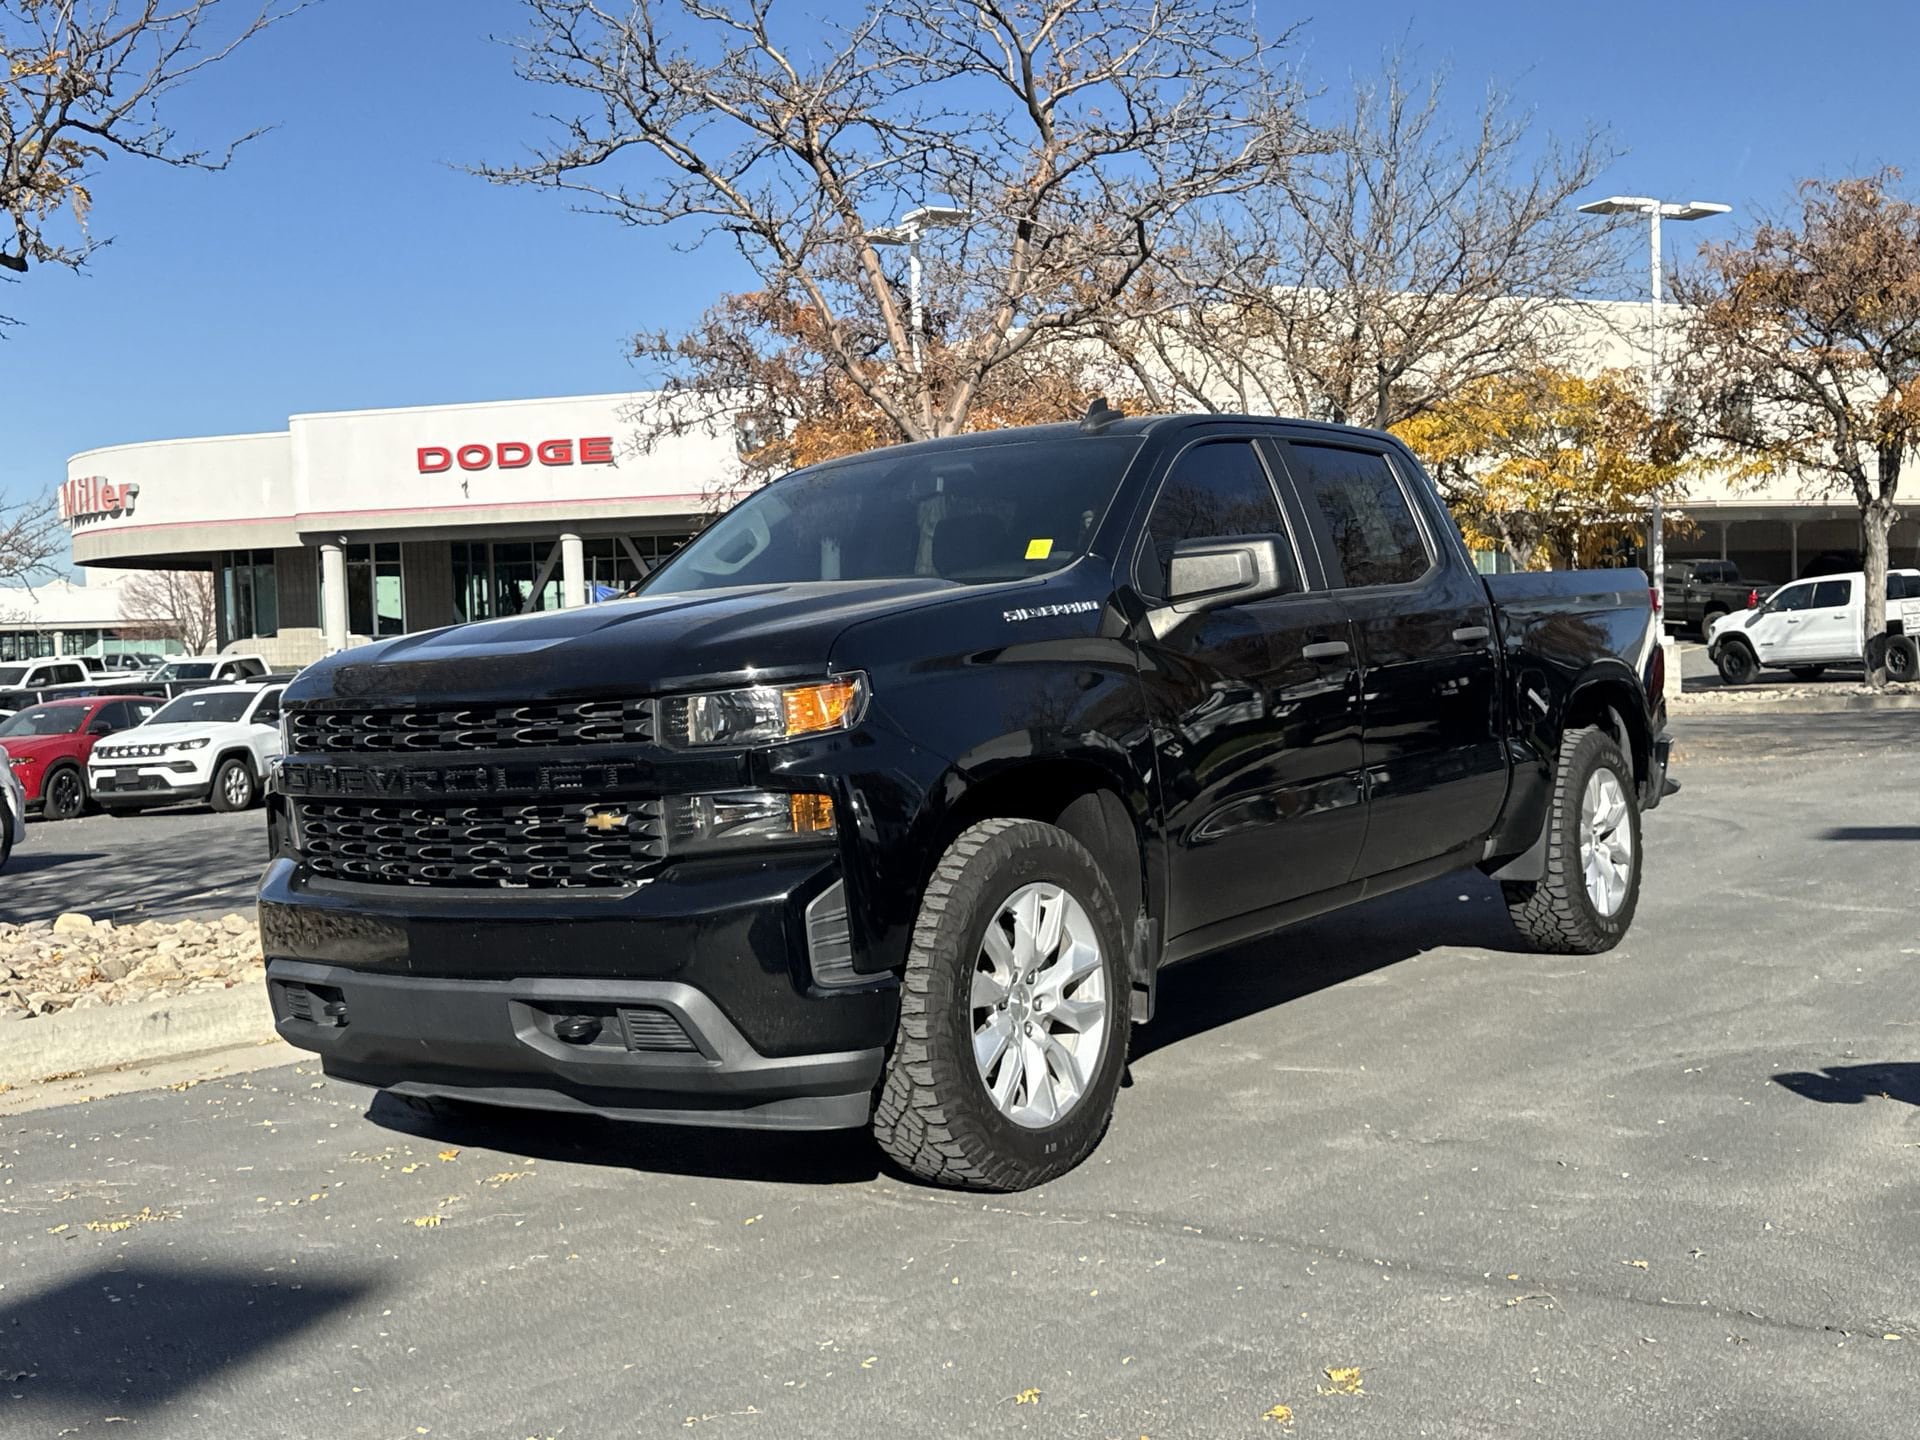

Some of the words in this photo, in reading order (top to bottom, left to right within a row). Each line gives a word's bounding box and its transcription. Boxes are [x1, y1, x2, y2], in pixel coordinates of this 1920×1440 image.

[417, 437, 613, 473] DODGE
[60, 476, 138, 518] Miller
[1003, 601, 1099, 622] SILVERADO
[285, 763, 635, 793] CHEVROLET
